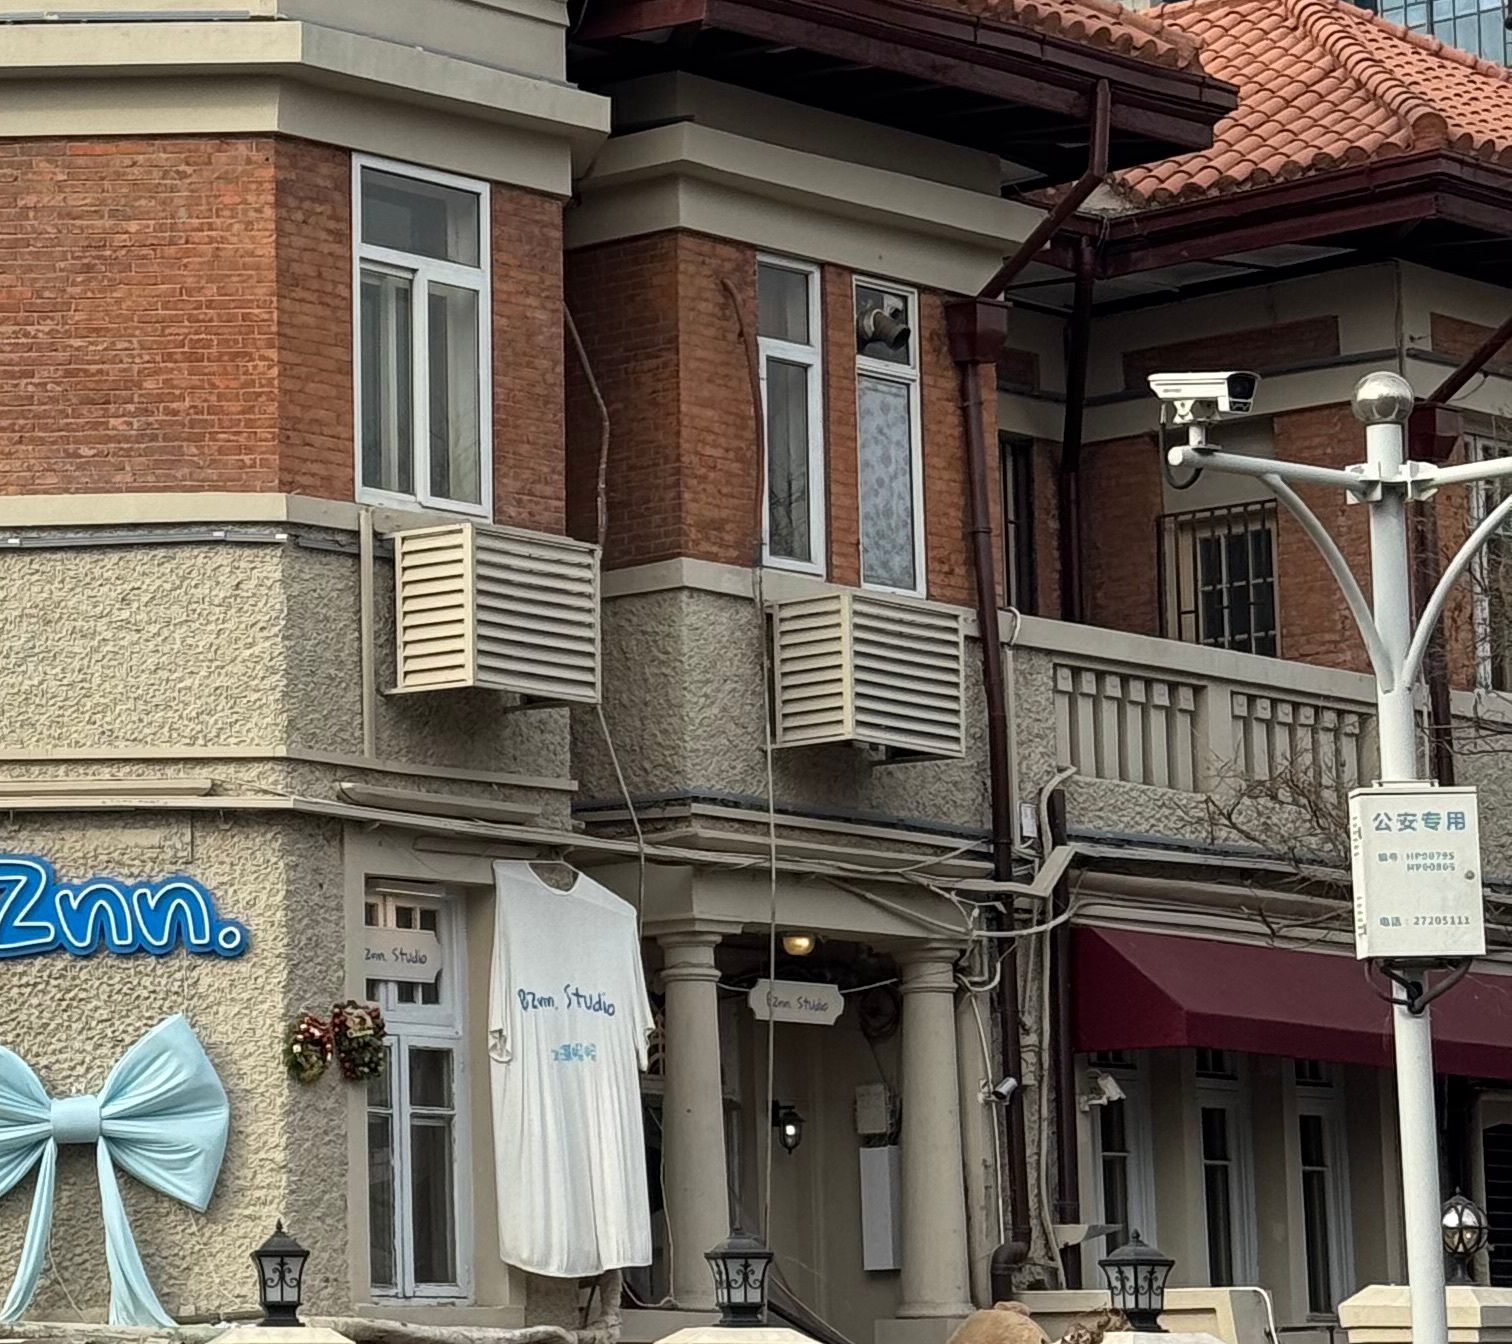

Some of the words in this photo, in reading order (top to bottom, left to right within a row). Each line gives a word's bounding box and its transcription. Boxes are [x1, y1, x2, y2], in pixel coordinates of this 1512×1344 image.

[1372, 810, 1466, 832] 公安专用
[391, 946, 428, 965] Studio
[563, 983, 616, 1017] Studio
[796, 995, 829, 1012] Studio
